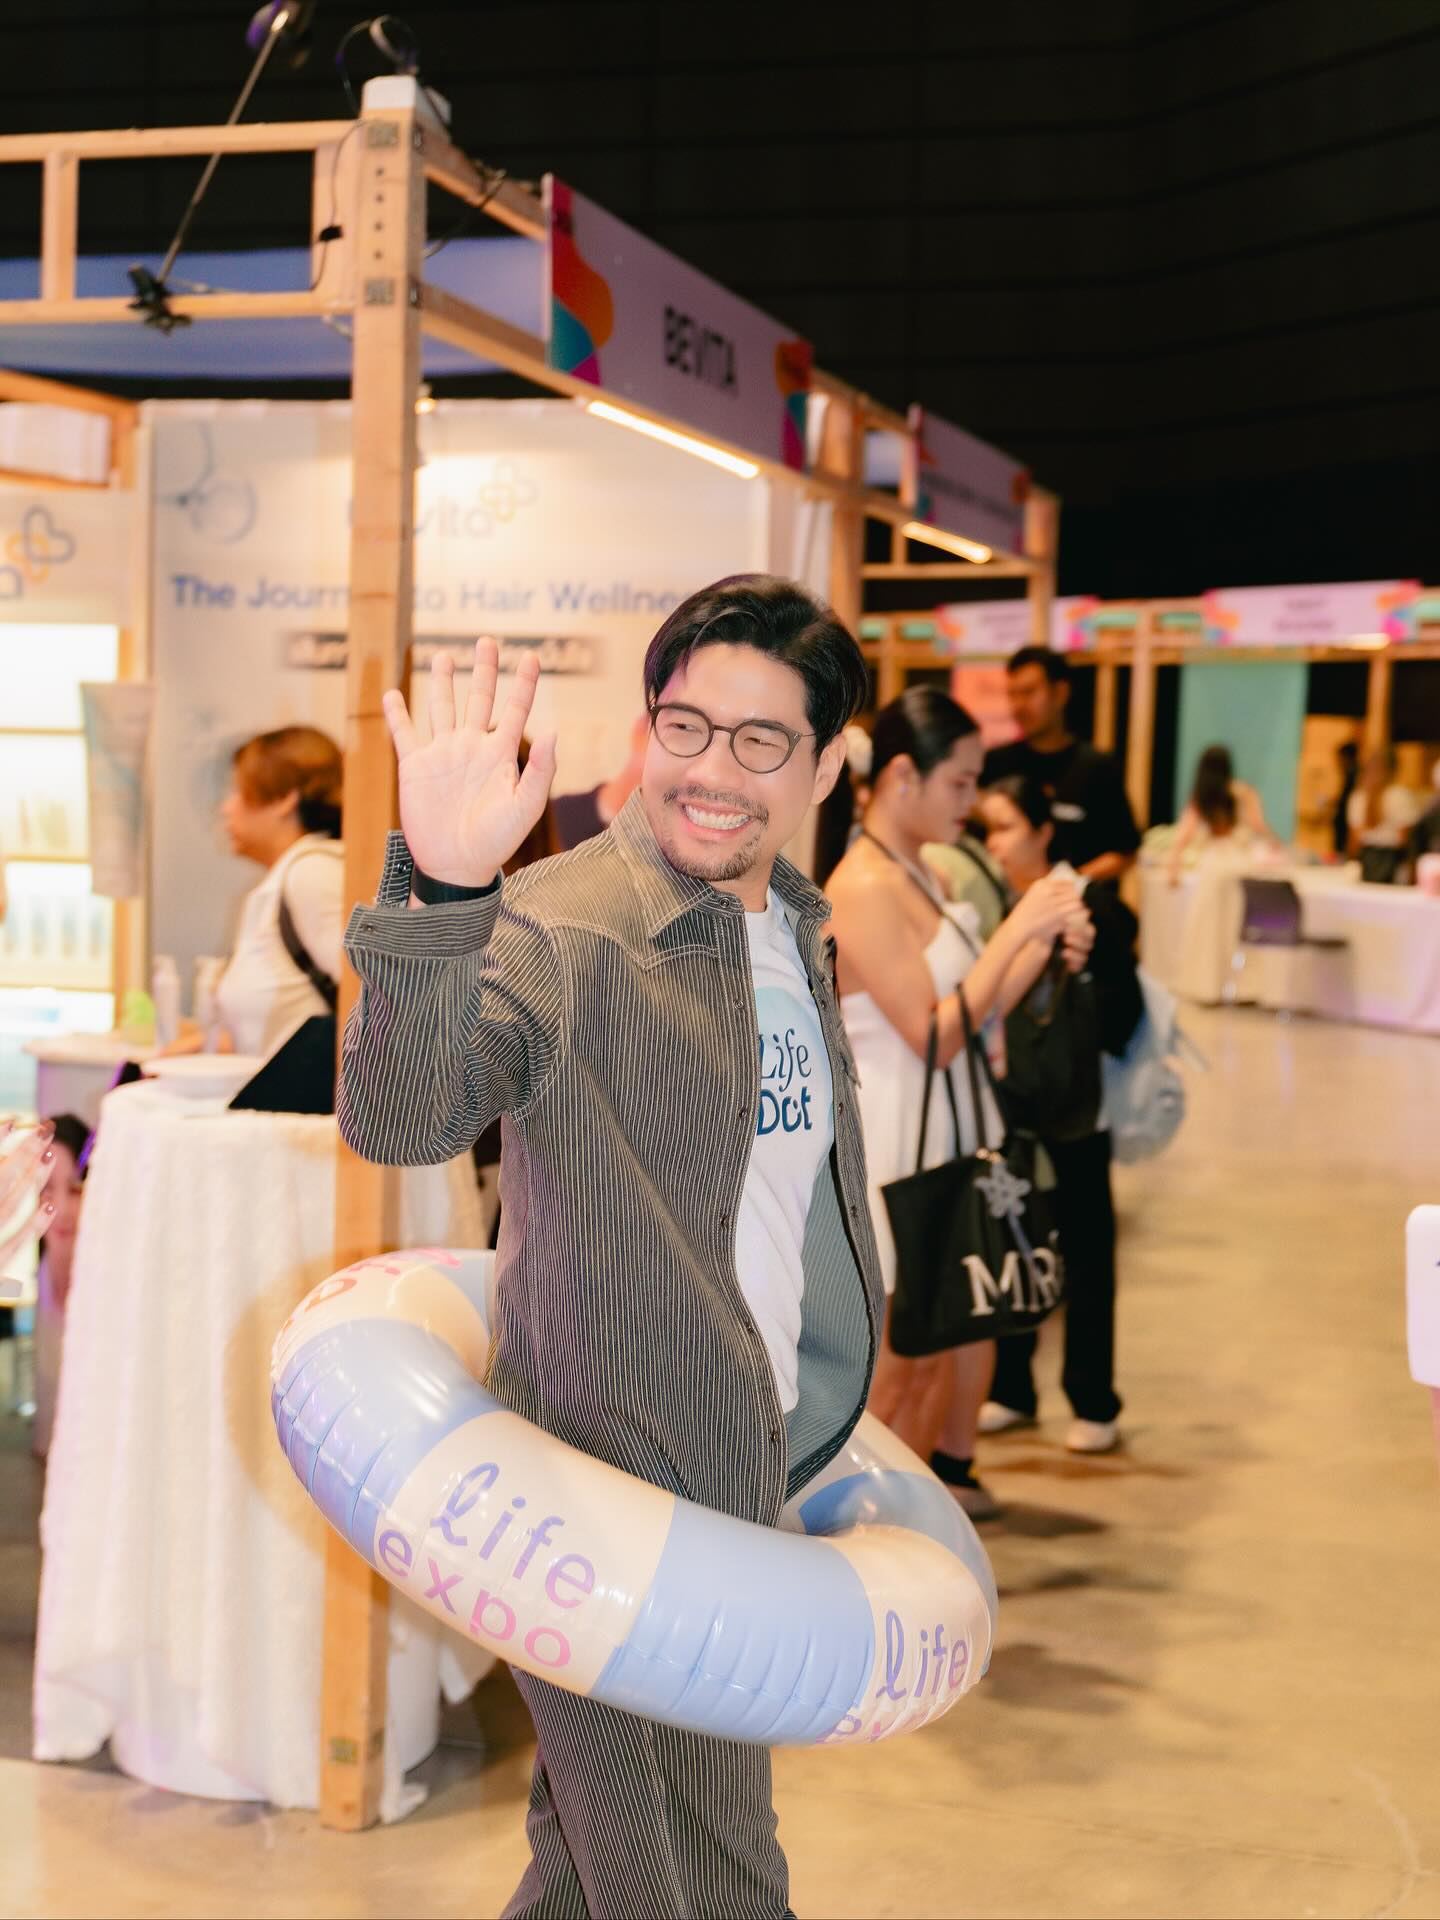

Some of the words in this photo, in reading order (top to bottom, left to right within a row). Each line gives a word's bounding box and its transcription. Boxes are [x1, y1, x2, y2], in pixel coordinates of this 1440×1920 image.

[171, 574, 236, 609] The
[247, 577, 350, 609] Journ
[458, 581, 537, 612] Hair
[548, 581, 694, 614] Wellne
[759, 1027, 812, 1092] Life
[757, 1086, 813, 1136] Dot
[429, 1461, 596, 1609] life
[378, 1528, 572, 1669] expo
[875, 1610, 969, 1701] life
